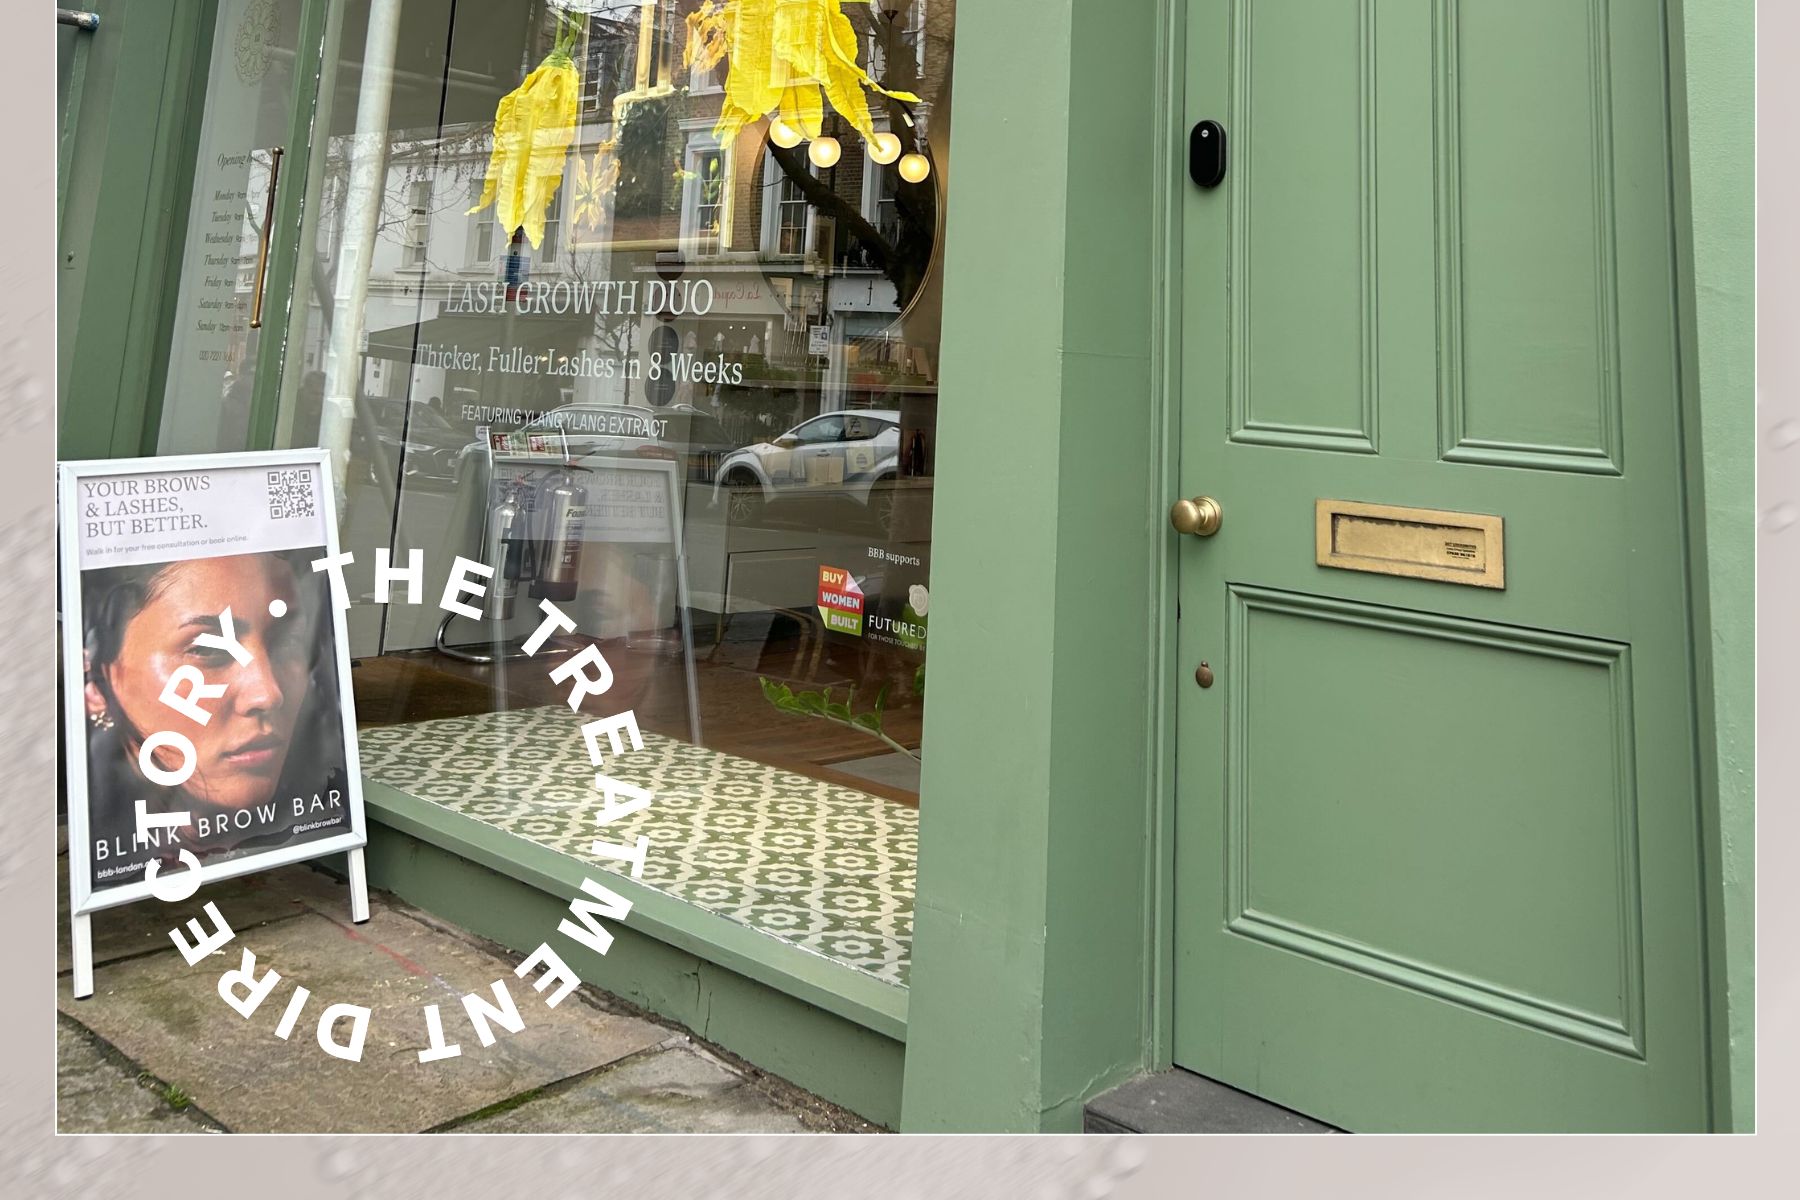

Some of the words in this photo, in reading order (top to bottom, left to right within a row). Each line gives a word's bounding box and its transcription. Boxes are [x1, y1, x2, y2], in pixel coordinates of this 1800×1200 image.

[217, 152, 246, 171] Opening
[444, 281, 509, 314] LASH
[516, 280, 639, 315] GROWTH
[645, 279, 714, 316] DUO
[417, 343, 482, 375] Thicker,
[487, 346, 541, 375] Fuller
[546, 348, 614, 380] Lashes
[621, 351, 641, 380] in
[648, 351, 662, 381] 8
[670, 352, 743, 386] Weeks
[461, 404, 522, 427] FEATURING
[524, 409, 562, 428] YLANG
[565, 411, 606, 433] YLANG
[609, 416, 668, 438] EXTRACT
[84, 480, 139, 498] YOUR
[144, 475, 210, 494] BROWS
[86, 502, 99, 518] &
[105, 496, 184, 517] LASHES,
[87, 520, 126, 538] BUT
[130, 514, 208, 534] BETTER.
[86, 547, 104, 556] Walk
[105, 546, 113, 554] in
[113, 545, 124, 553] for
[124, 545, 141, 555] your
[142, 543, 156, 551] free
[157, 539, 200, 550] consultation
[209, 536, 226, 545] book
[868, 547, 884, 559] BBB
[885, 552, 920, 566] supports
[822, 571, 844, 585] BUY
[822, 591, 860, 609] WOMEN
[831, 614, 858, 630] BUILT
[868, 614, 927, 639] FUTURED
[96, 823, 181, 861] BLINK
[198, 803, 276, 839] BROW
[293, 789, 342, 818] BAR
[292, 816, 343, 834] @blinkbrowbar
[97, 858, 162, 879] bbb-london.cm
